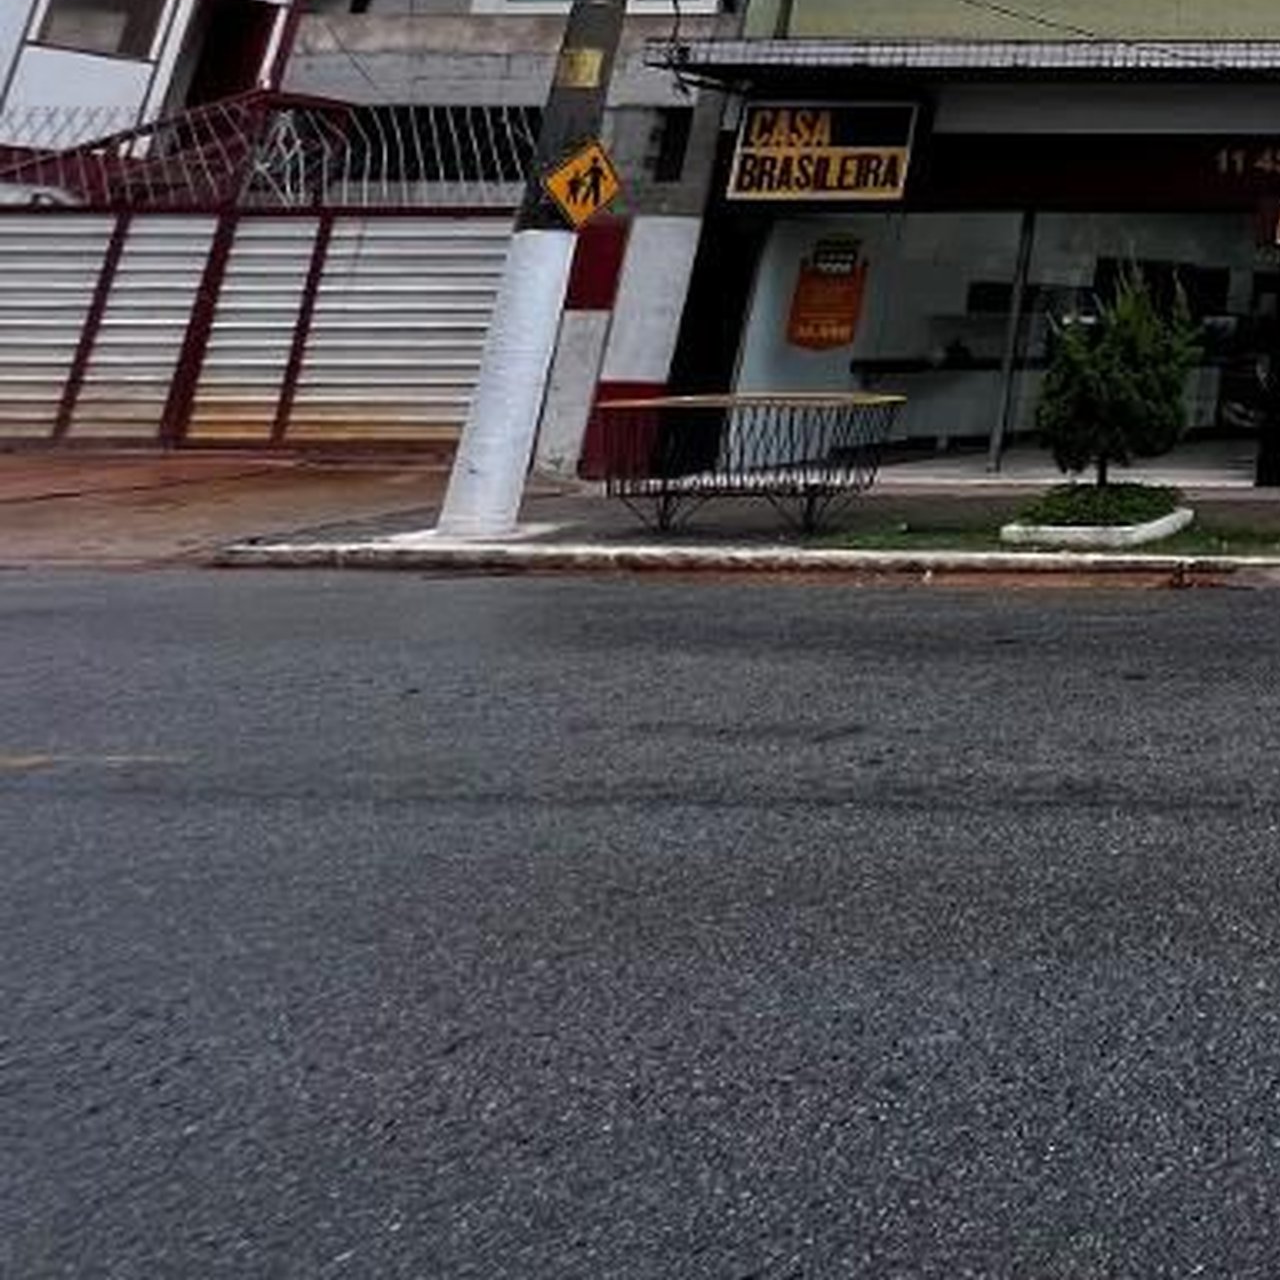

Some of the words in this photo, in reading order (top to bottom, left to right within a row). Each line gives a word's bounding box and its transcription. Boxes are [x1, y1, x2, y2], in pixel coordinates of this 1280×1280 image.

[748, 110, 832, 148] CASA
[735, 153, 900, 192] BRASILEIRA
[1215, 148, 1248, 174] 11
